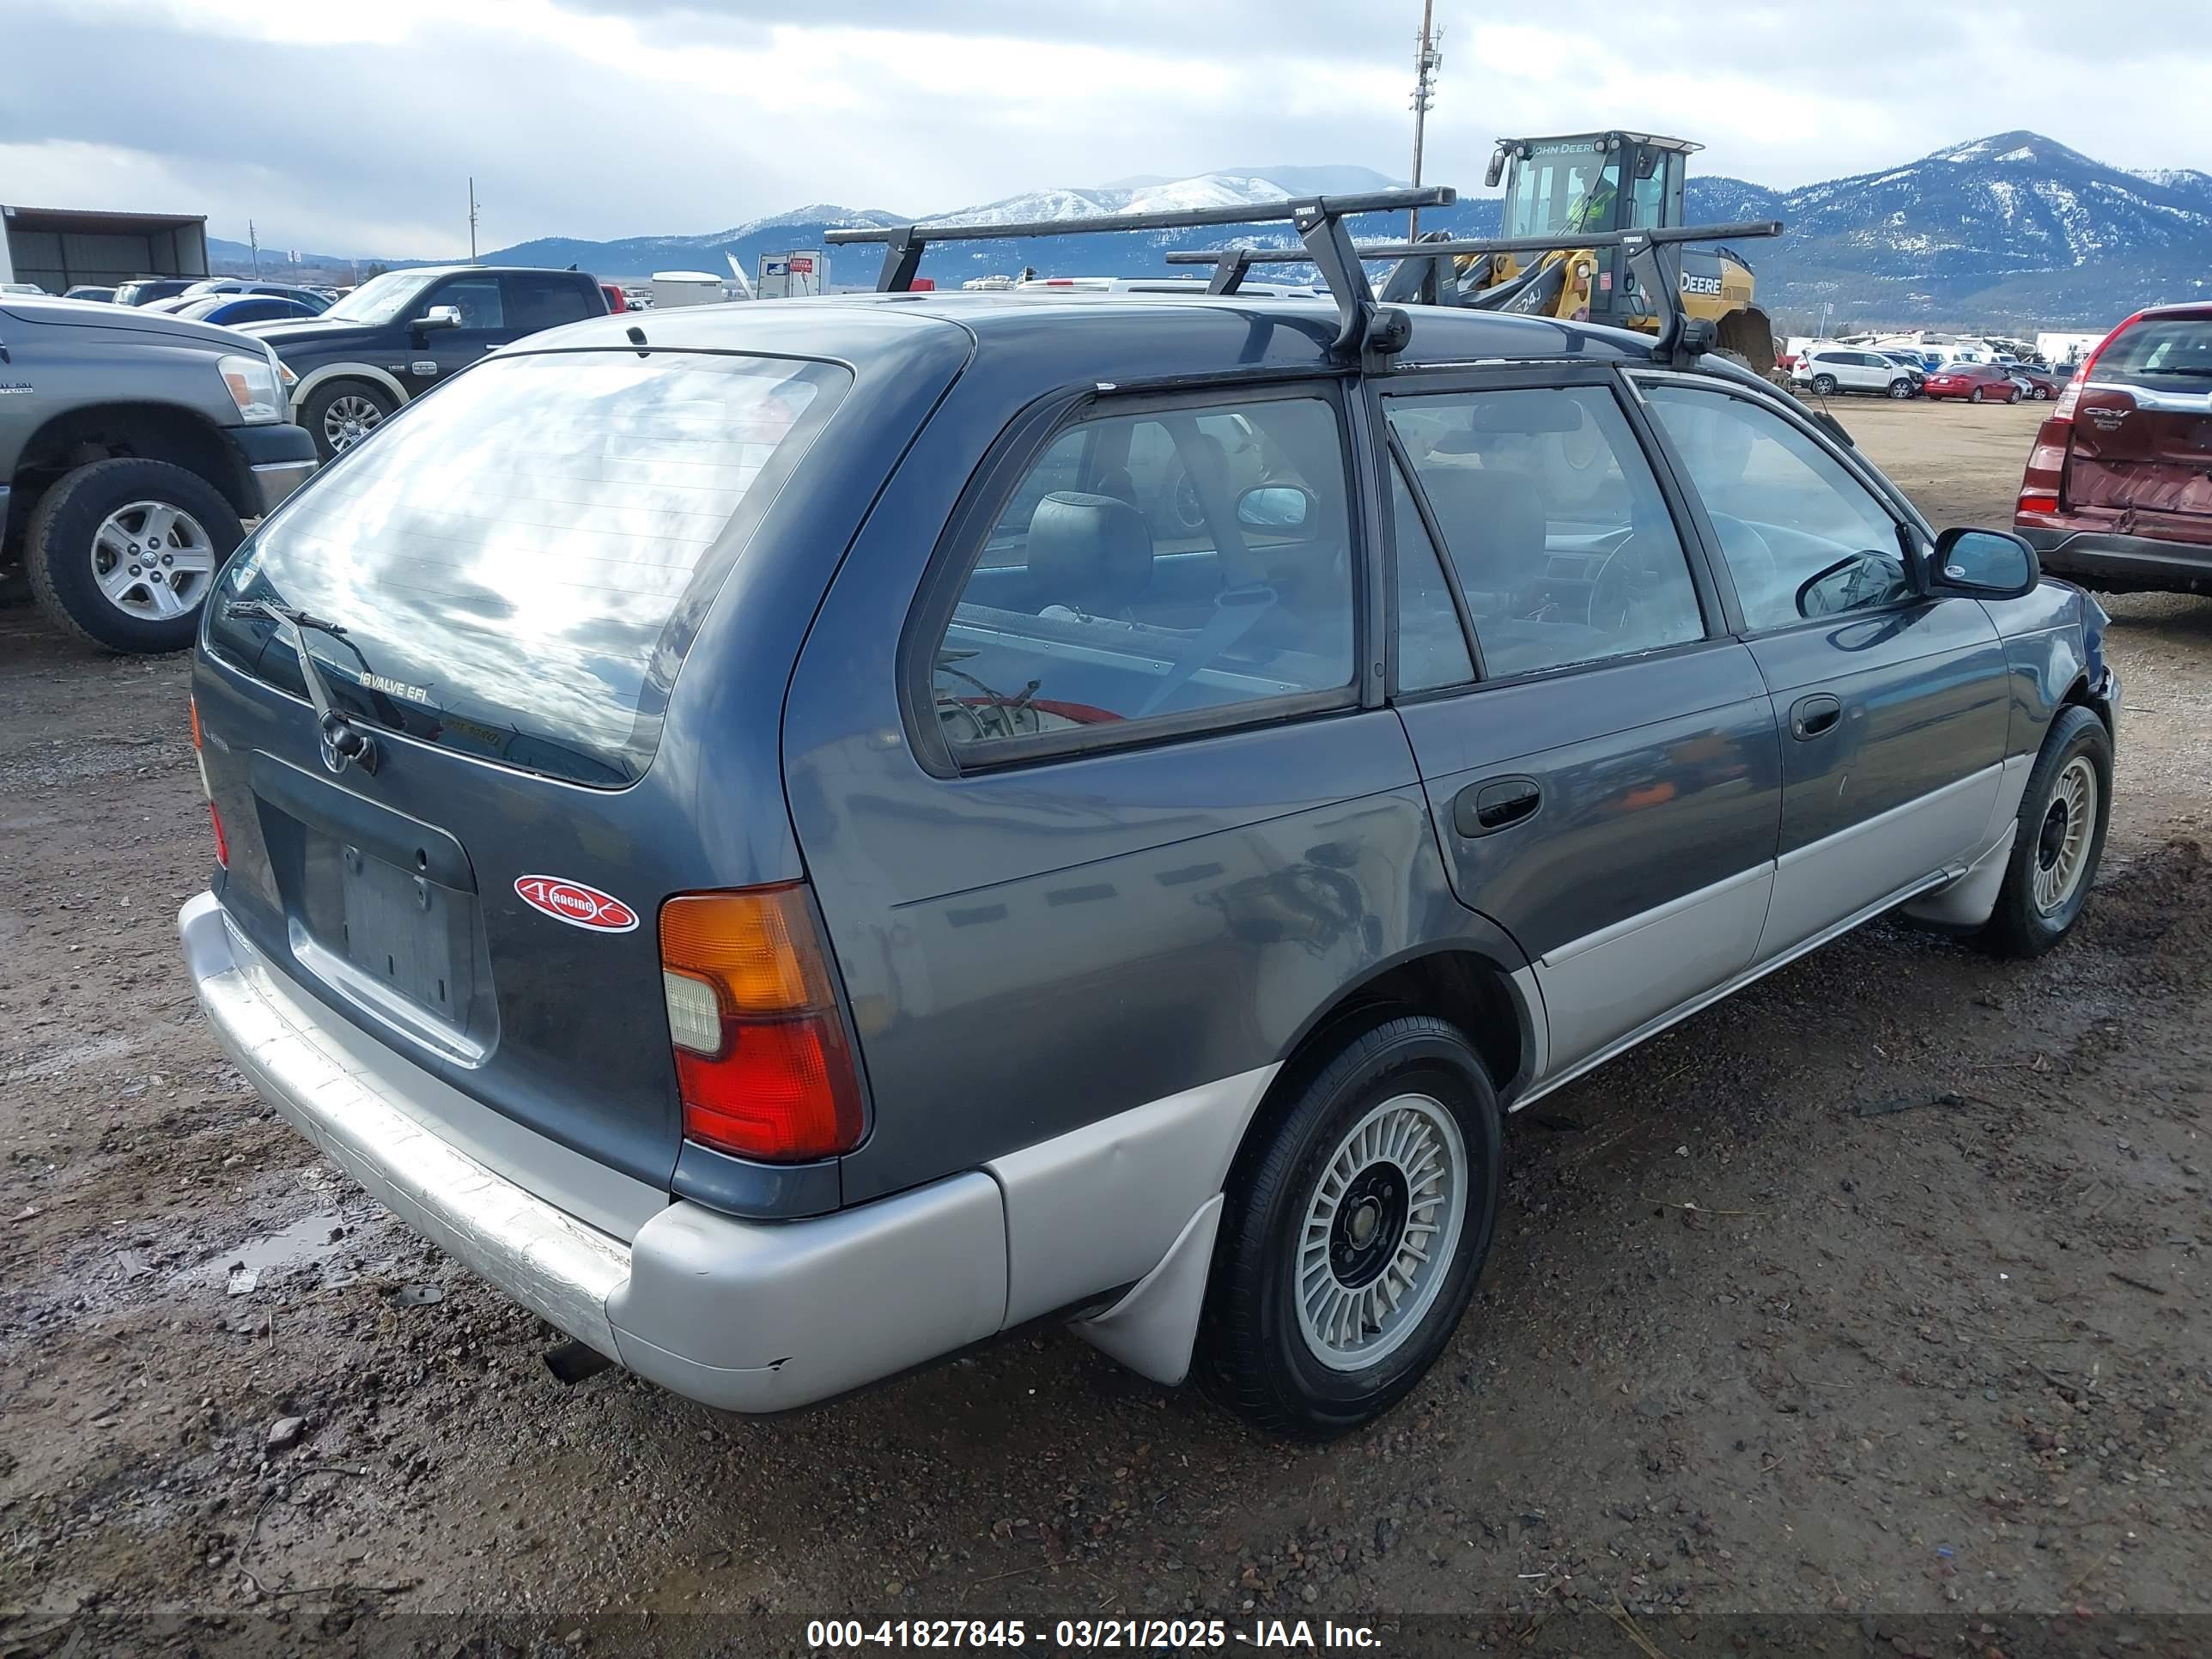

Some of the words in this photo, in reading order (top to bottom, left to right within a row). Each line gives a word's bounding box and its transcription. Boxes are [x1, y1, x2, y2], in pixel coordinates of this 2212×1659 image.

[1529, 145, 1559, 155] JOHN
[1295, 206, 1316, 216] THULE
[1682, 271, 1722, 295] DEERE
[406, 686, 427, 702] EFI
